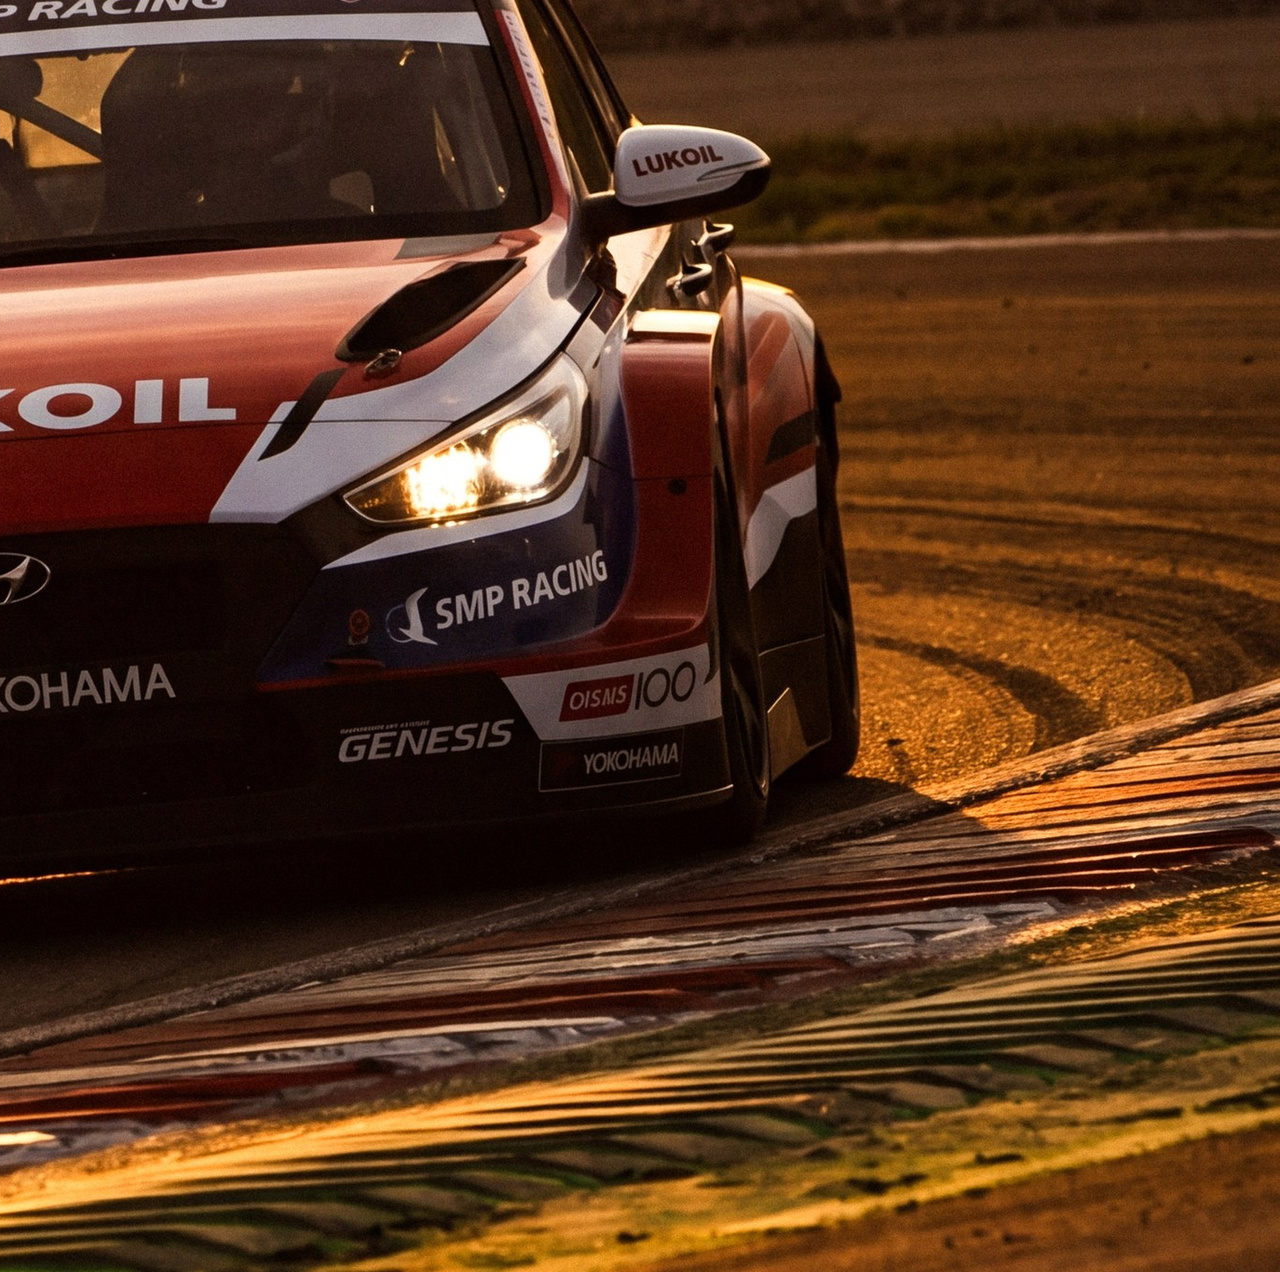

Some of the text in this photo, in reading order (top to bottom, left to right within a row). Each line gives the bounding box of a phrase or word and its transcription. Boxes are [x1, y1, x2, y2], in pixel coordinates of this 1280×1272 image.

[632, 145, 724, 177] LUKOIL
[435, 549, 608, 630] SMP RACING
[338, 718, 516, 763] GENESIS
[583, 741, 679, 775] YOKOHAMA
